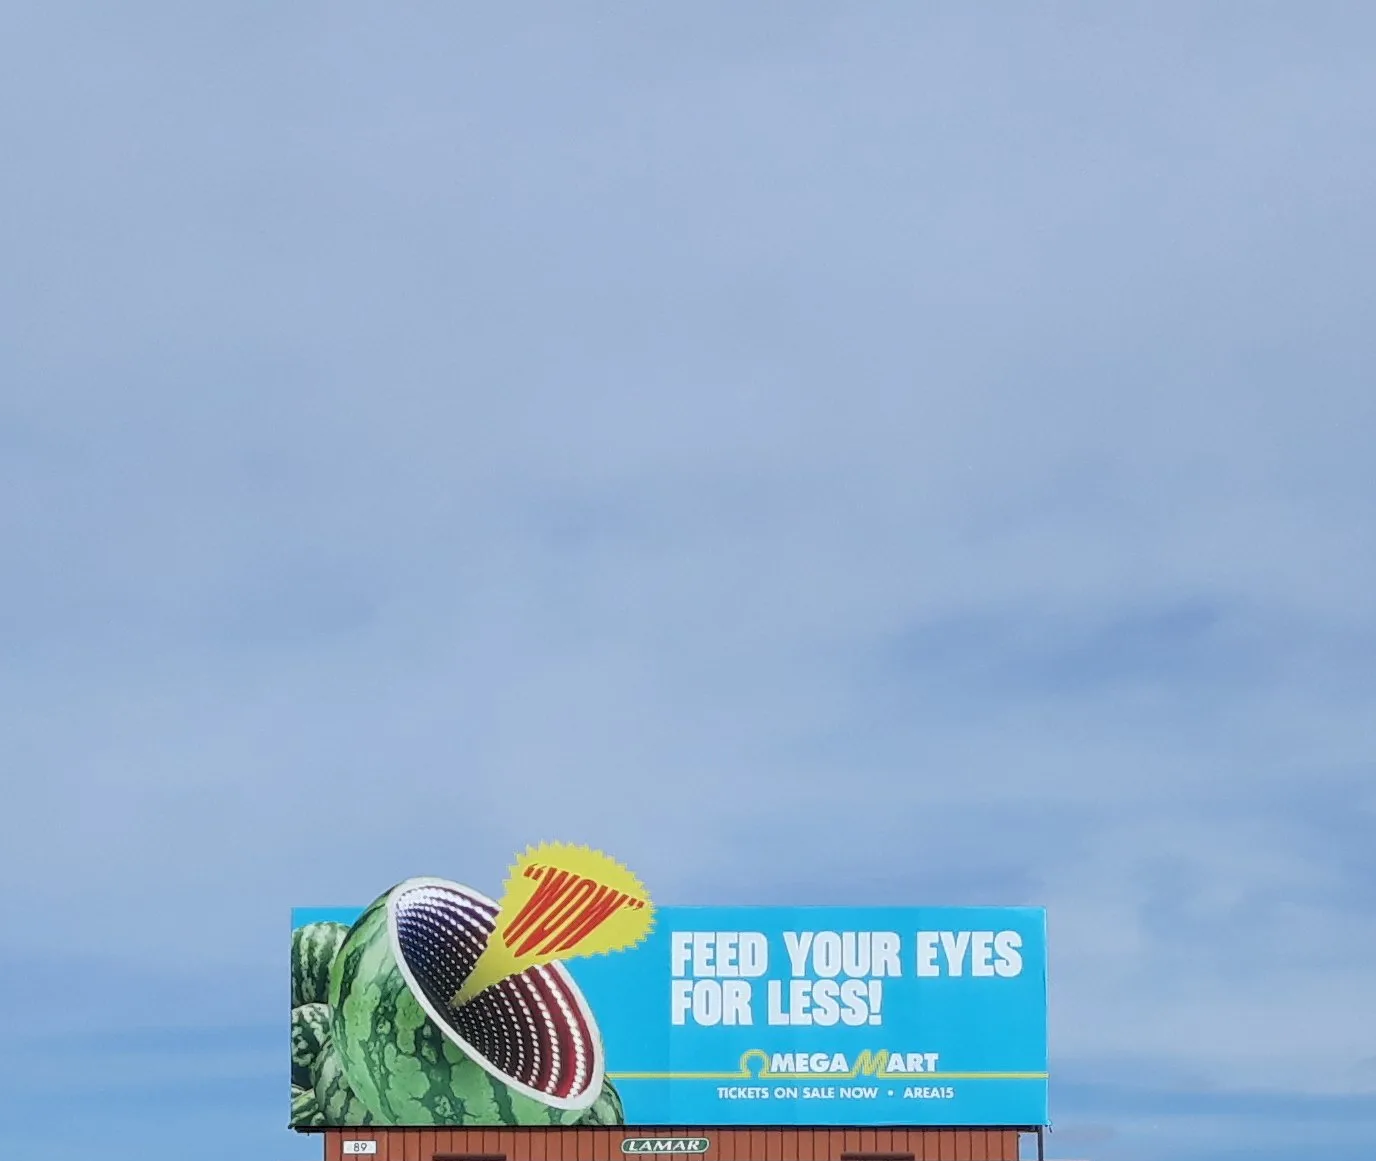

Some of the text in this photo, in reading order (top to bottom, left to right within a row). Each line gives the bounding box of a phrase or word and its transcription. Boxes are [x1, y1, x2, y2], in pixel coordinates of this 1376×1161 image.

[671, 930, 1024, 978] FEED YOUR EYES
[671, 979, 883, 1026] FOR LESS!
[851, 1049, 939, 1078] MART
[717, 1086, 955, 1100] TICKETS ON SALE NOW AREA15
[353, 1142, 368, 1152] 89
[628, 1140, 701, 1152] LAMAR
